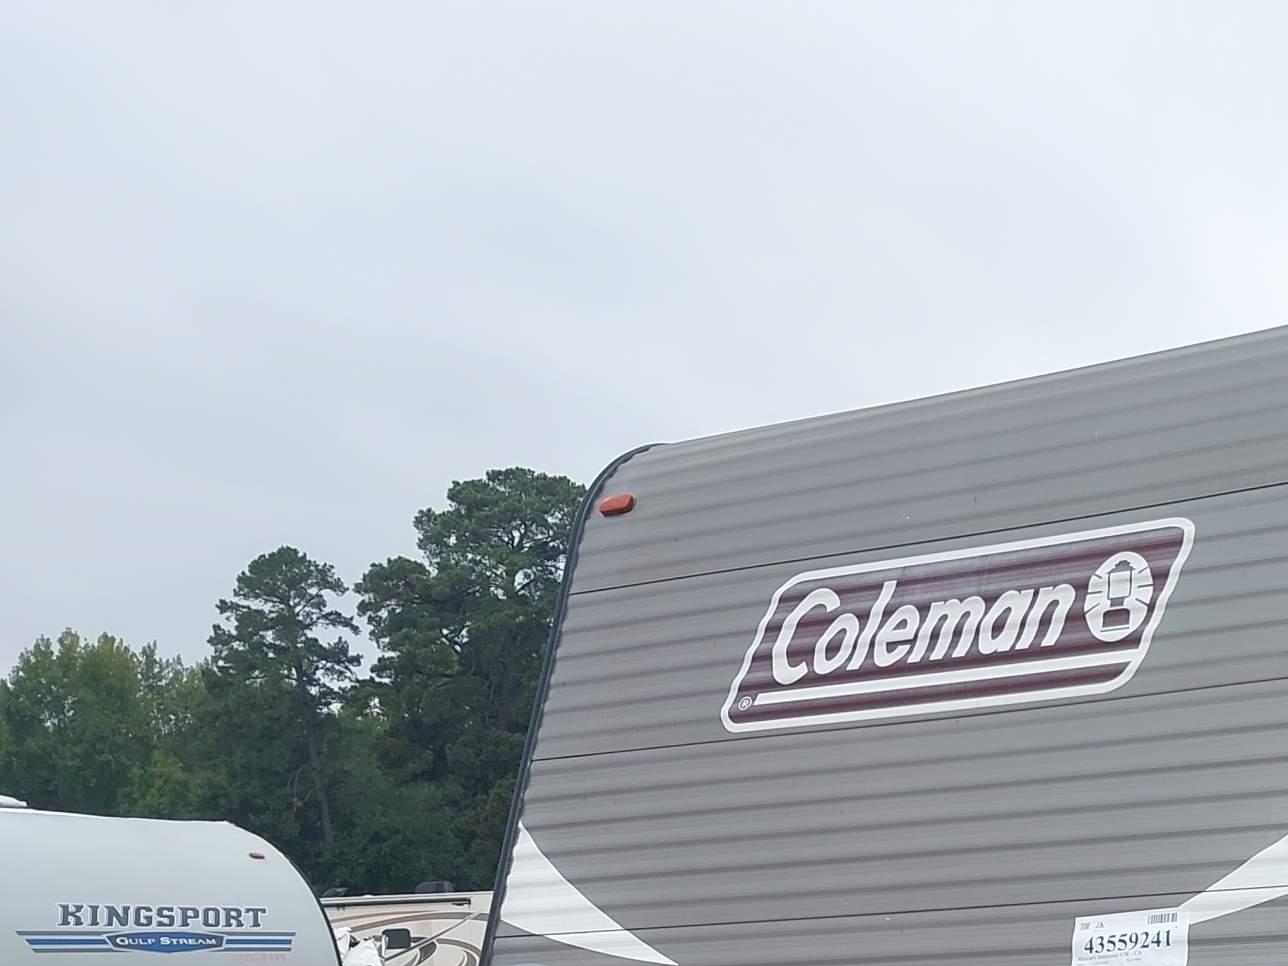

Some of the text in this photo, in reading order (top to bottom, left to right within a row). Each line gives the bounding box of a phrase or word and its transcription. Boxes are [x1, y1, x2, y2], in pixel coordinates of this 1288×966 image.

[771, 579, 1076, 686] Coleman
[56, 903, 267, 928] KINGSPORT
[116, 936, 217, 946] GULF STREAM
[1083, 929, 1171, 954] 43559241
